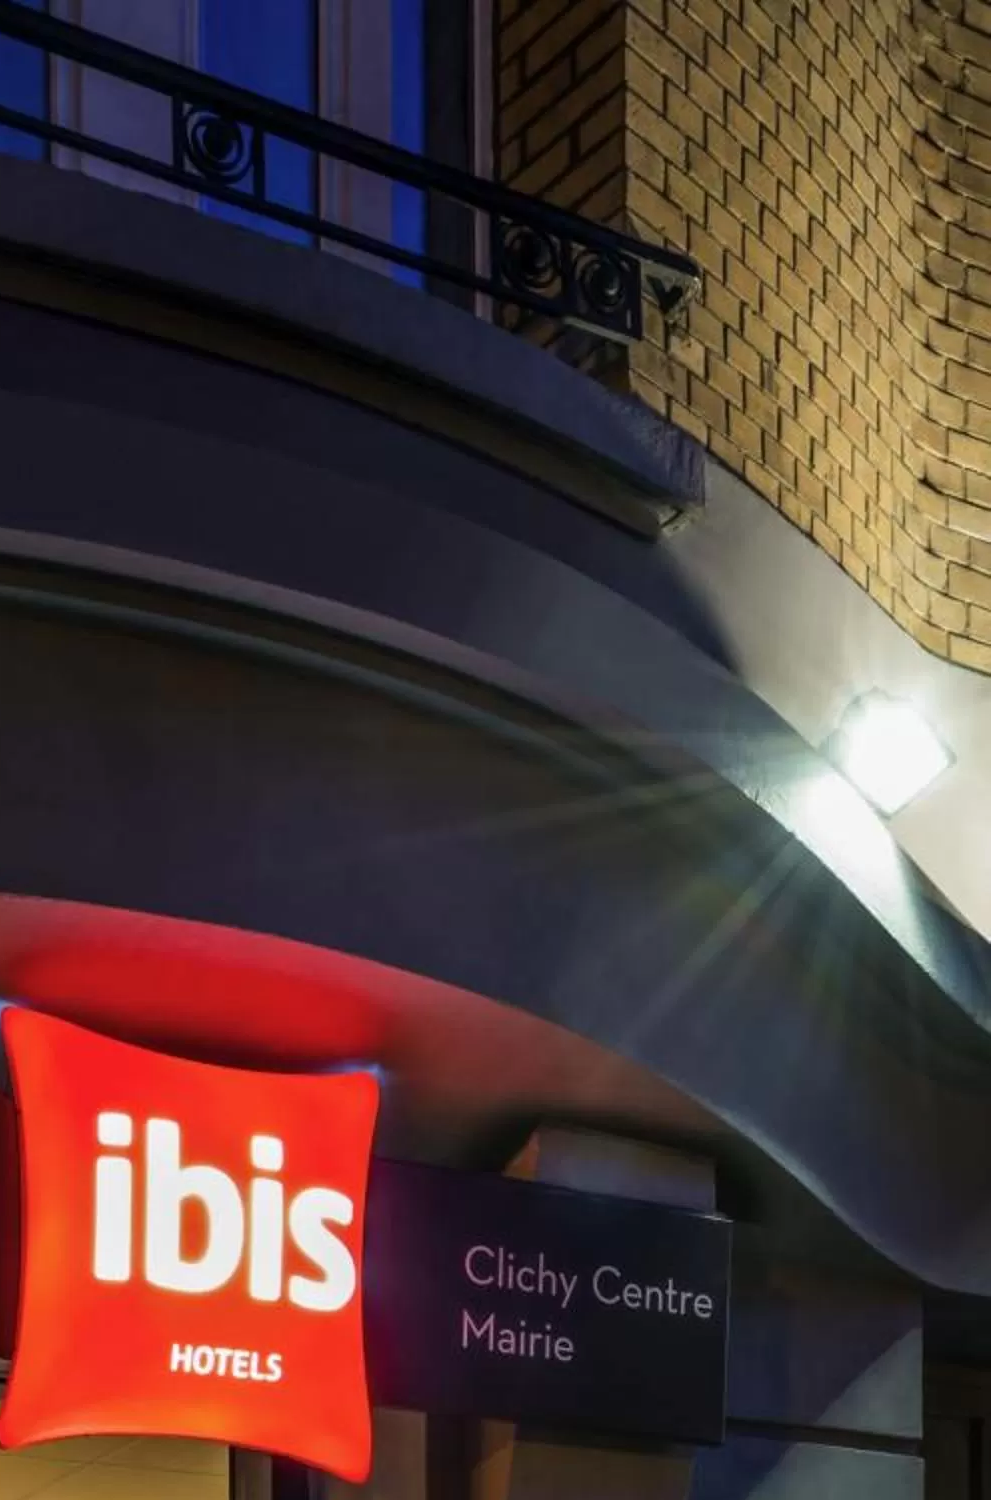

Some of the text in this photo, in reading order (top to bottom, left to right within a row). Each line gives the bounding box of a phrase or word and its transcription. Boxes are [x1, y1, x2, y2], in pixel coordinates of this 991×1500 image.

[93, 1112, 356, 1312] ibis
[464, 1245, 713, 1318] Clichy Centre
[170, 1343, 282, 1383] HOTELS
[461, 1308, 574, 1361] Mairie
